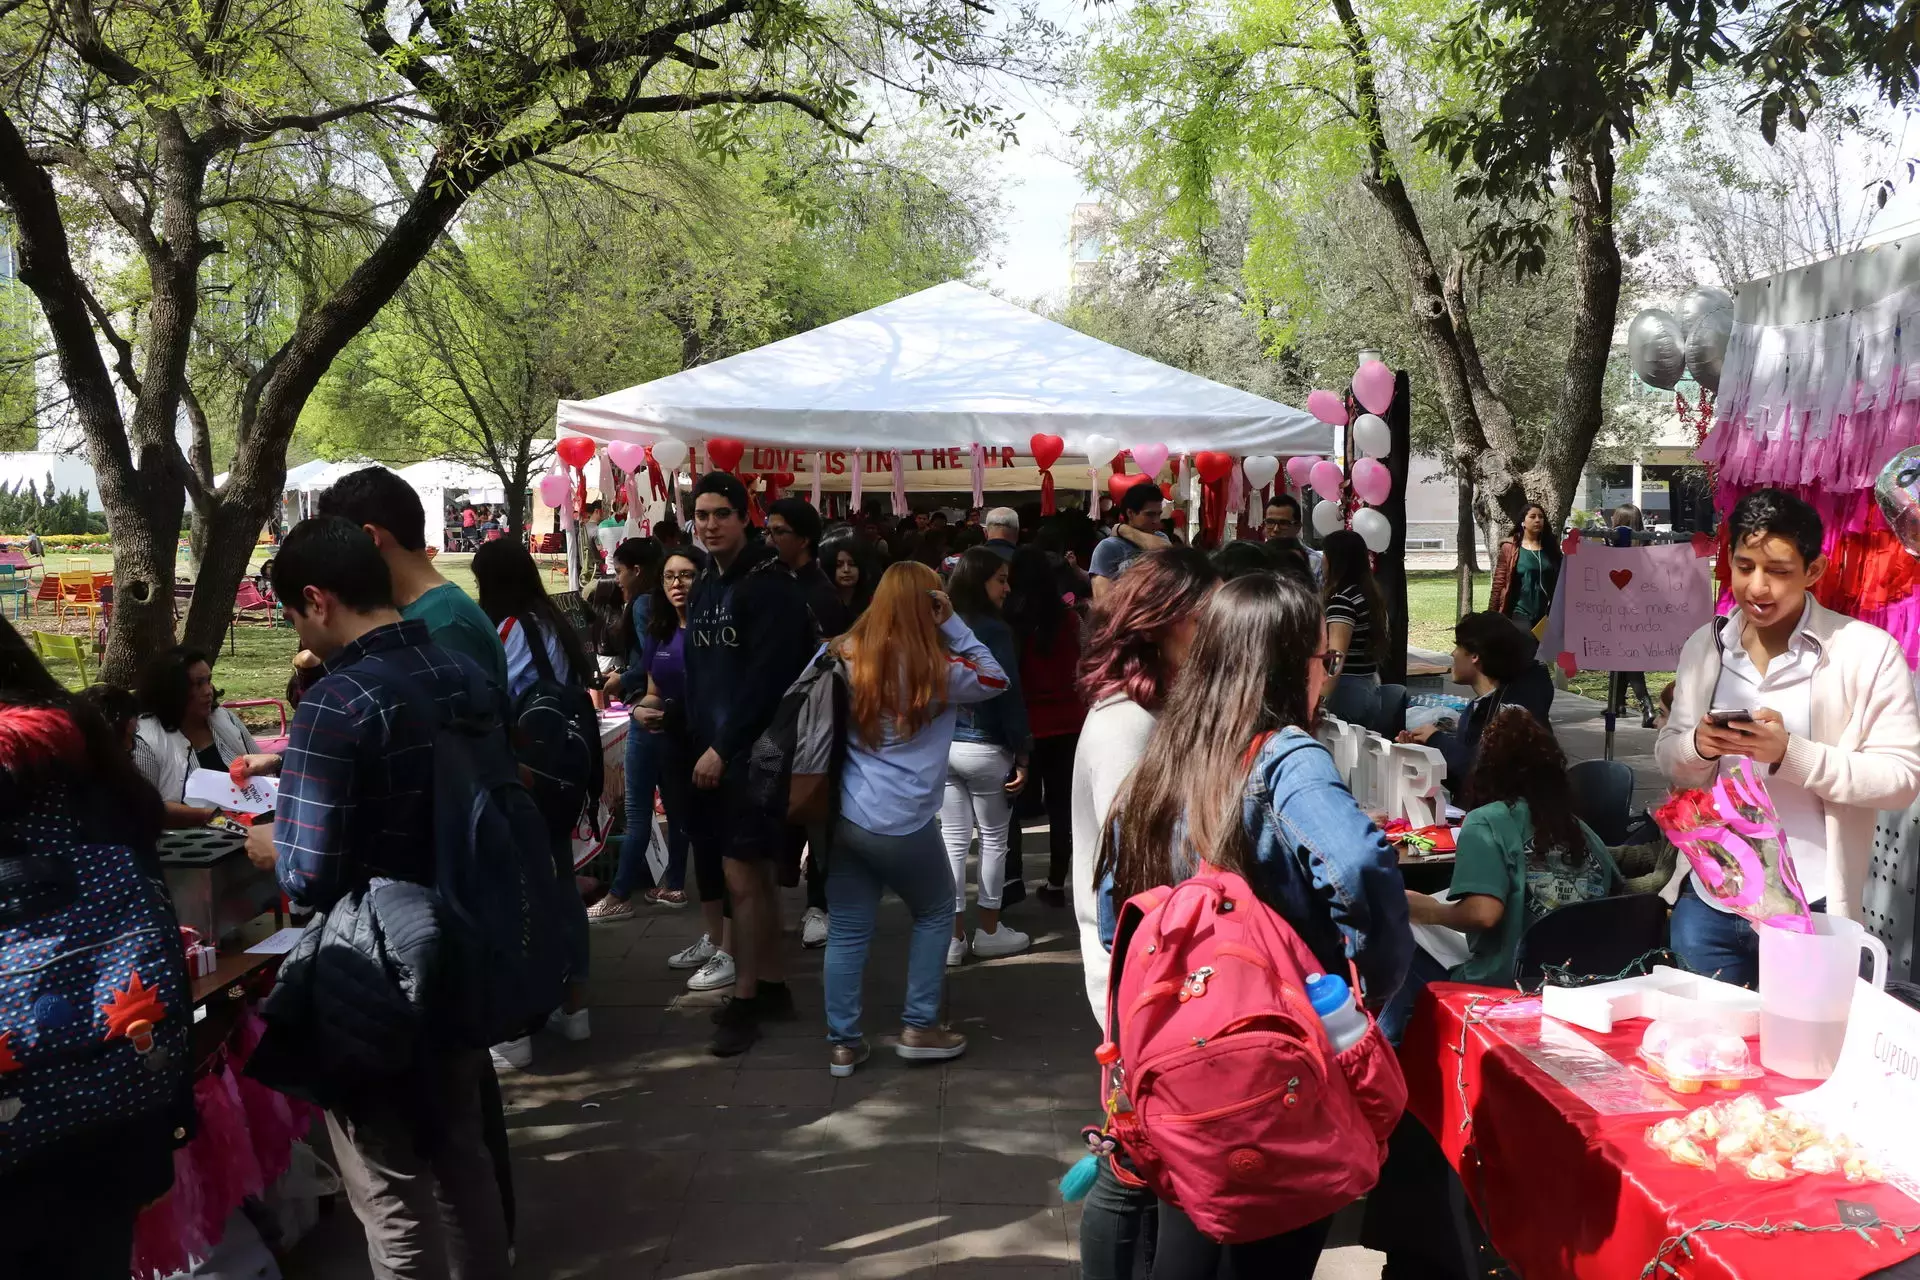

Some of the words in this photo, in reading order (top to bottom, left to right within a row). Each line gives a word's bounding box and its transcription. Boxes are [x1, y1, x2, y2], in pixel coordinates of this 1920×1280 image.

[752, 447, 806, 472] LOVE
[825, 451, 846, 475] IS
[866, 451, 893, 473] IN
[911, 446, 963, 471] THE
[1584, 566, 1601, 592] El
[1640, 581, 1660, 593] es
[1666, 568, 1684, 593] la
[1617, 605, 1640, 617] que
[1645, 602, 1689, 616] mueve
[1601, 615, 1612, 633] al
[1618, 640, 1640, 658] San
